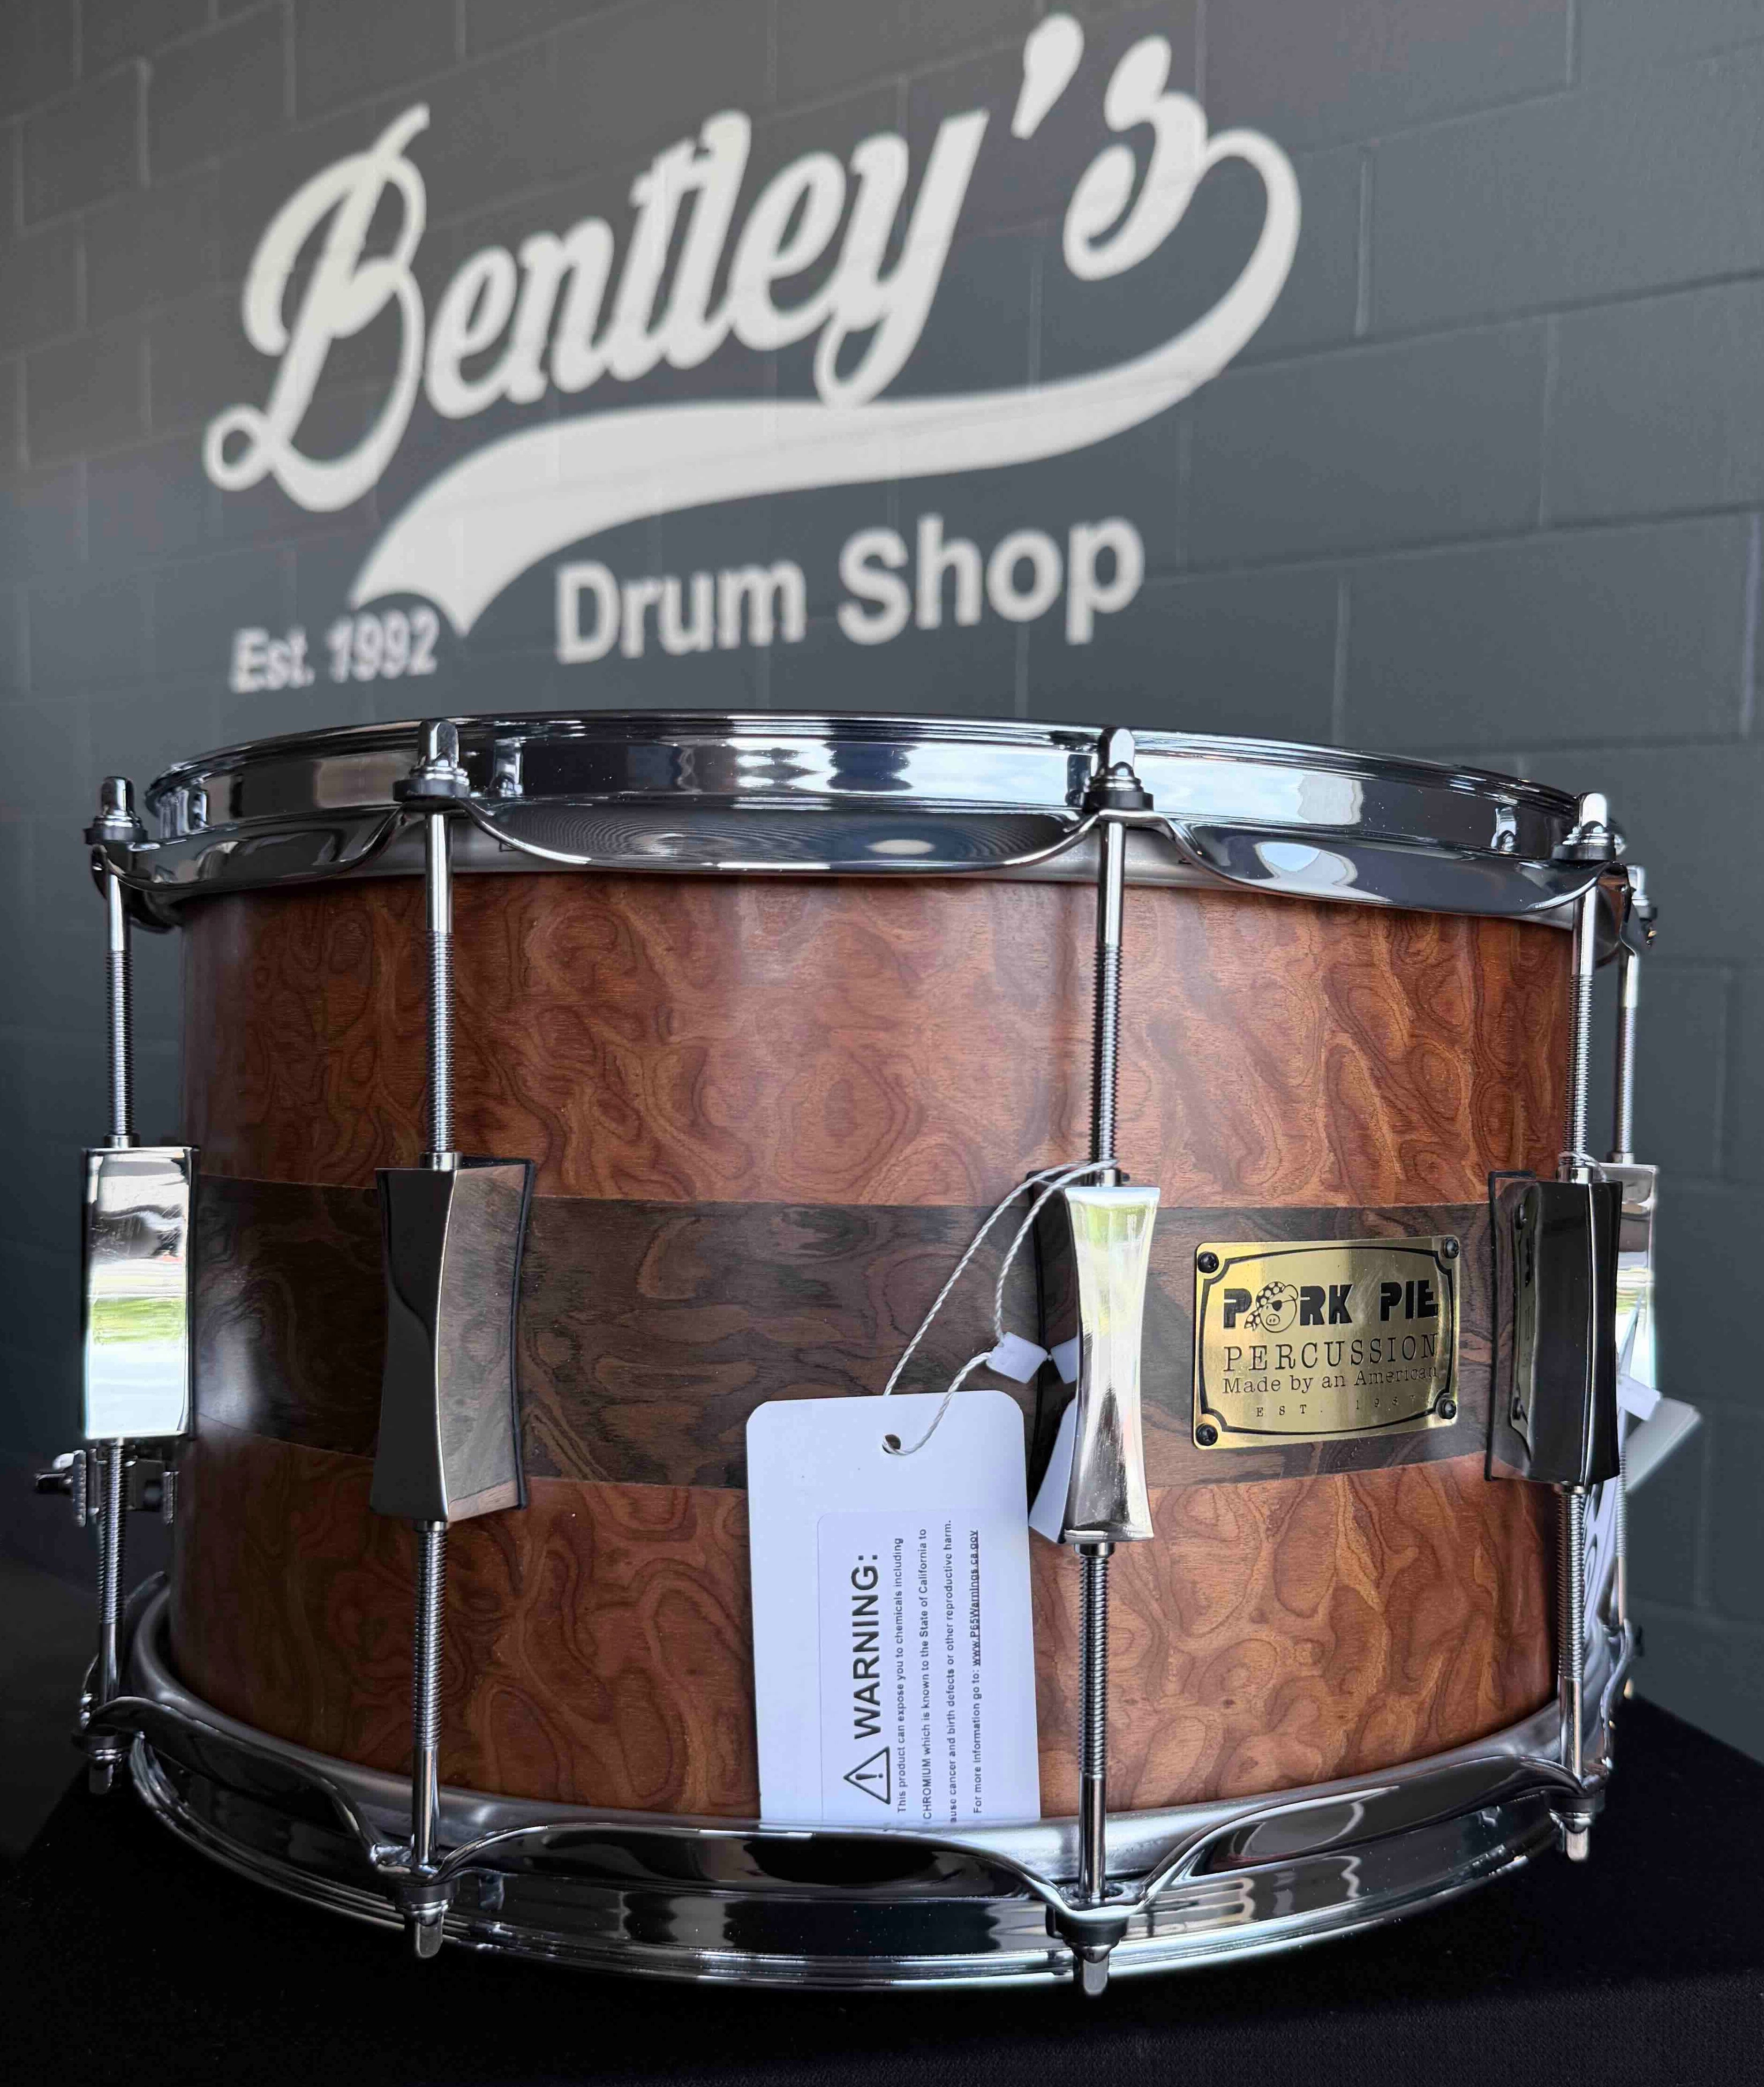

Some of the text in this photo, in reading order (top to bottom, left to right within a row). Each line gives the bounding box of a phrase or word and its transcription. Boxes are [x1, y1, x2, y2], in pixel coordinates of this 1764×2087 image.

[204, 13, 1210, 512] Bentley's
[556, 512, 1145, 664] Drum Shop
[230, 605, 440, 693] Est. 1992
[1380, 1279, 1439, 1321] PIE
[1223, 1333, 1438, 1372] PERCUSSION
[1222, 1366, 1438, 1394] Made by an American
[893, 1538, 904, 1587] including
[943, 1553, 955, 1620] reproductive
[970, 1529, 980, 1666] www.P65Warnings.ca.gov
[894, 1590, 903, 1644] chemicals
[945, 1624, 954, 1650] other
[851, 1553, 881, 1739] WARNING:
[895, 1647, 903, 1658] to
[947, 1653, 954, 1665] or
[896, 1660, 906, 1681] you
[918, 1529, 932, 1819] CHROMIUM which is known to the State of California to
[946, 1668, 955, 1707] defects
[972, 1669, 980, 1683] to:
[897, 1684, 906, 1721] expose
[972, 1686, 982, 1700] go
[947, 1710, 955, 1734] birth
[972, 1703, 980, 1763] information
[897, 1746, 908, 1788] product
[897, 1791, 906, 1813] This
